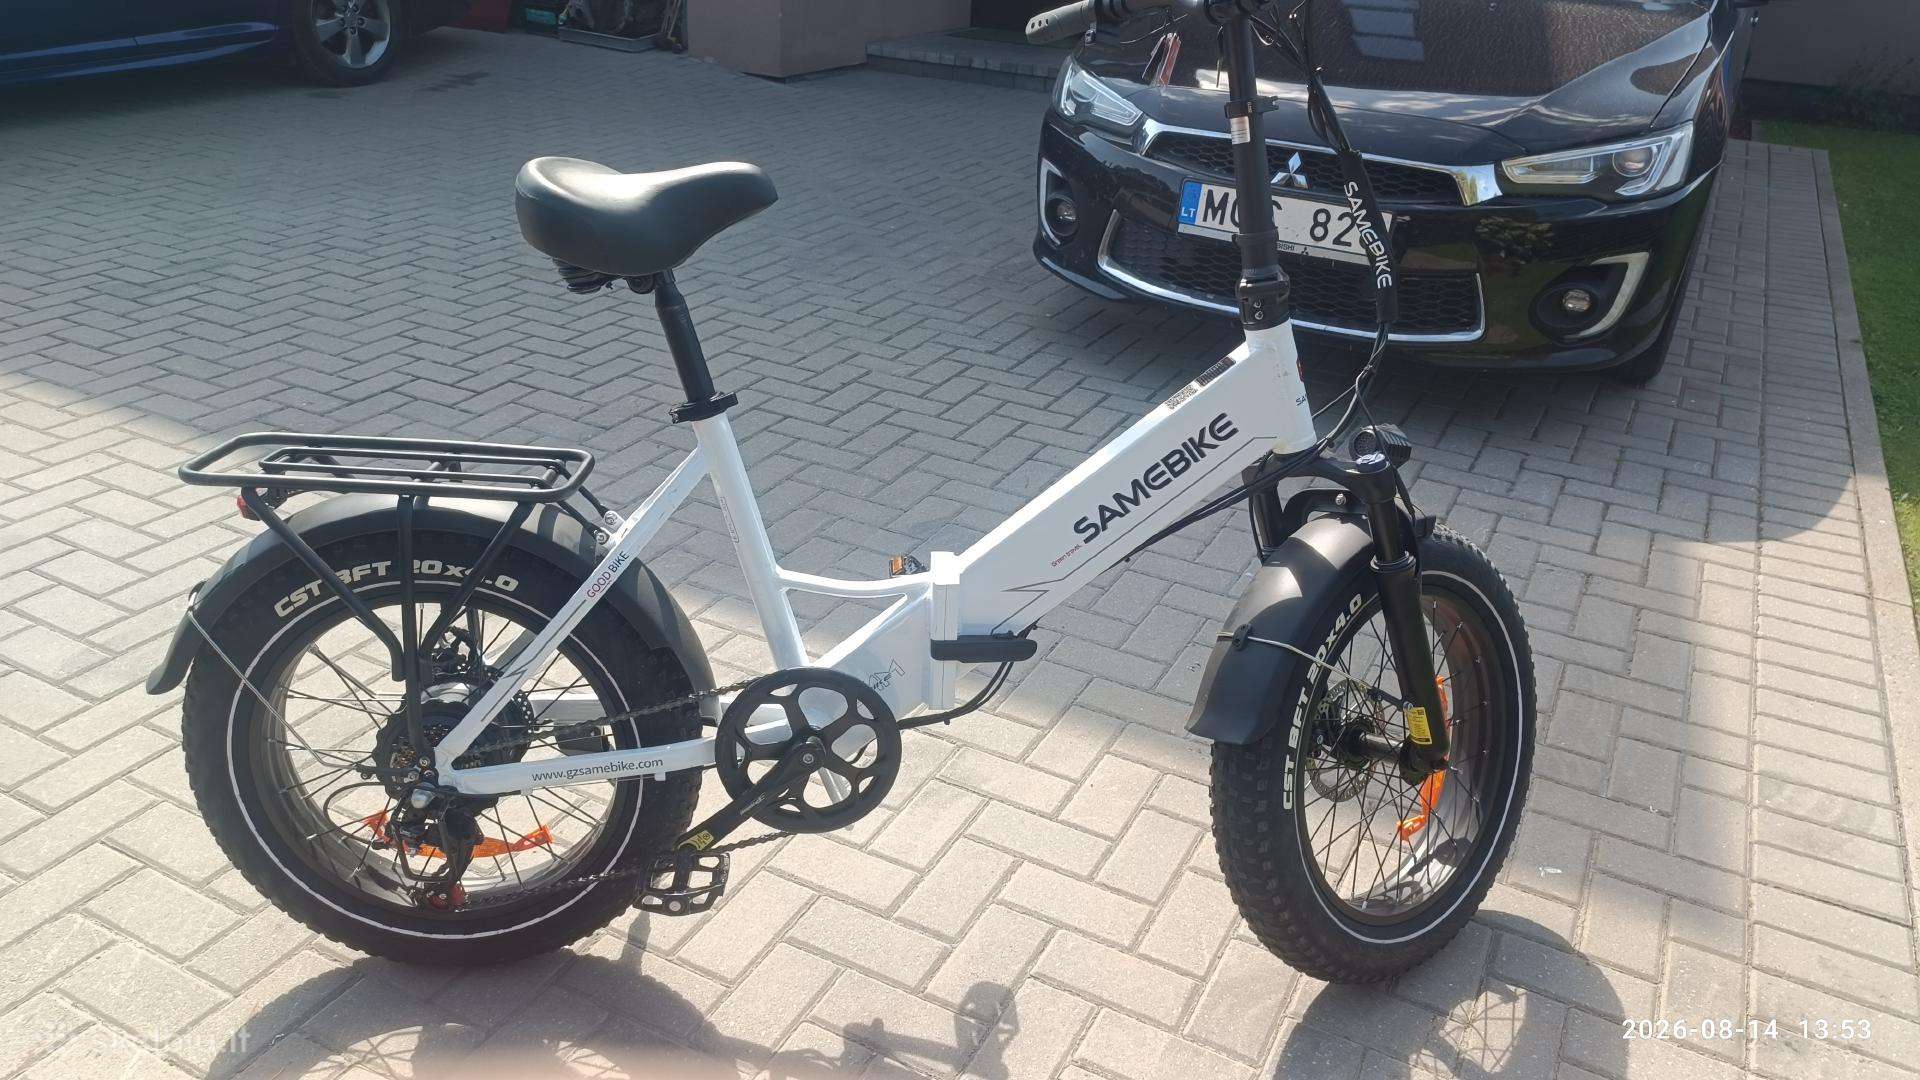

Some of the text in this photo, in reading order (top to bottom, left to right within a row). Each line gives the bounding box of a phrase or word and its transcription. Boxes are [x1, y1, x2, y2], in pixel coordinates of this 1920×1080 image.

[1181, 206, 1196, 218] LT
[1343, 181, 1392, 289] SAMEBIKE
[1073, 412, 1240, 545] SAMEBIKE
[587, 550, 630, 598] GOOD BIKE
[274, 579, 323, 618] CST
[531, 758, 664, 781] www.gzsamebike.com
[1283, 754, 1295, 810] CST
